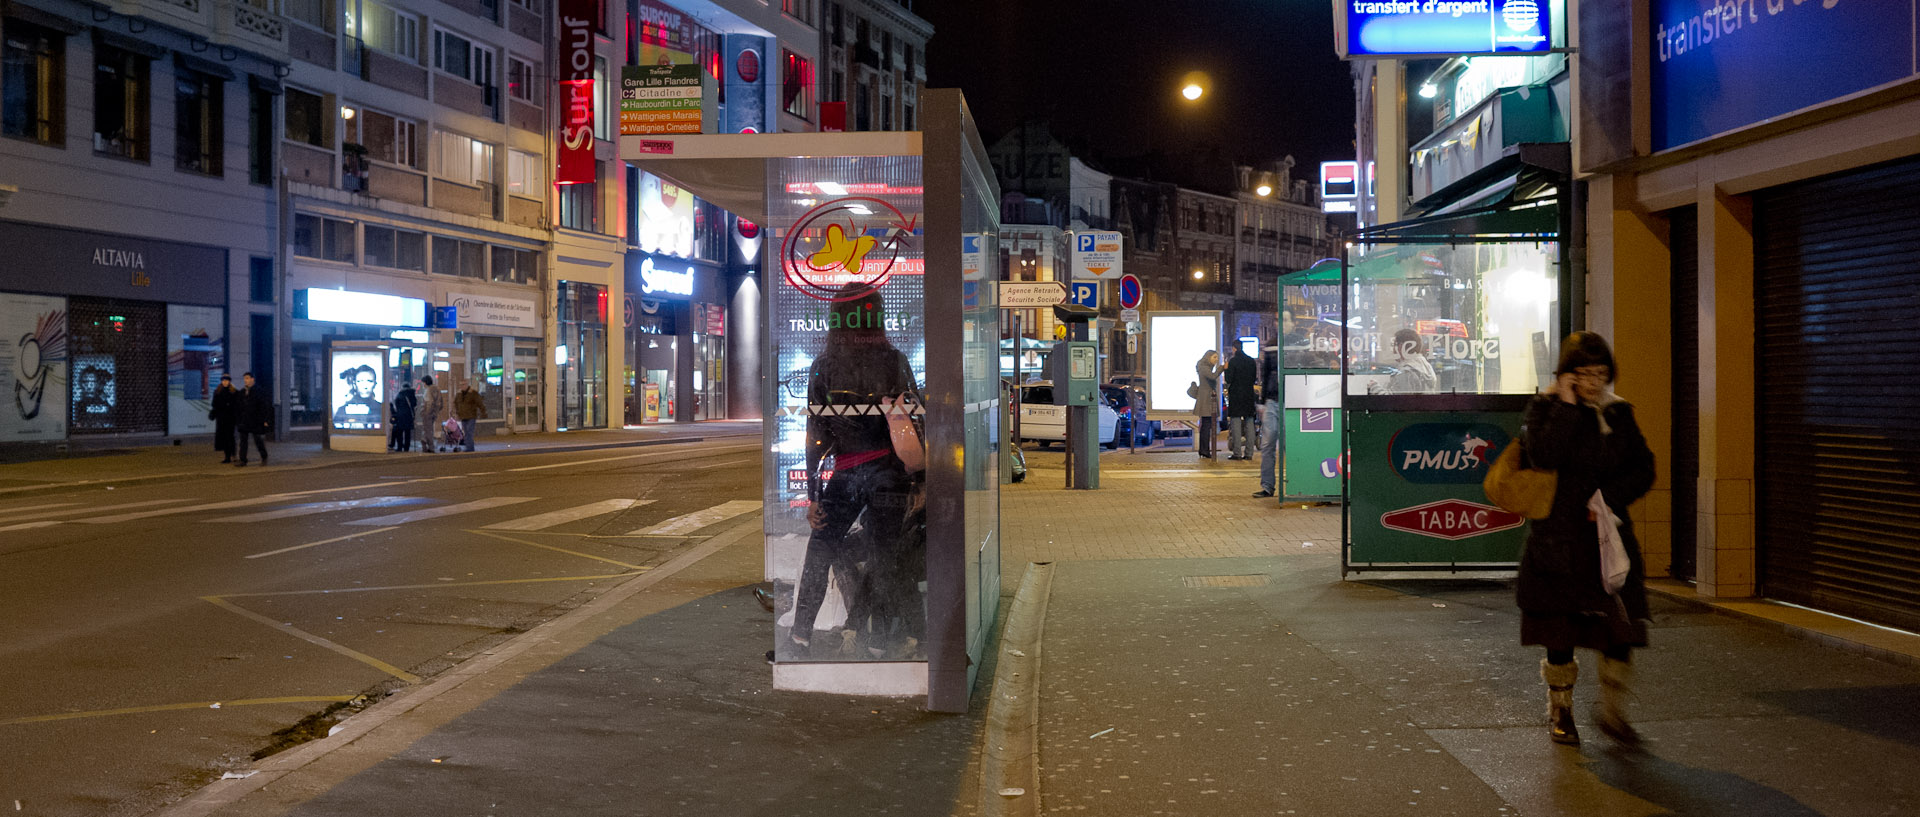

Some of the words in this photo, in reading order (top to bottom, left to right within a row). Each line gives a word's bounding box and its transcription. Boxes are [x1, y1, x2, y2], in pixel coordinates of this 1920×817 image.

[1354, 0, 1420, 14] transfert
[1422, 0, 1488, 18] d'argent
[640, 5, 680, 31] SURCOUF
[1657, 0, 1759, 63] transfert
[562, 15, 594, 151] Surcouf
[624, 78, 645, 87] Gare
[646, 78, 662, 86] Lille
[664, 77, 699, 85] Flandres
[622, 89, 636, 99] C2
[629, 100, 671, 109] Haubourdin
[683, 99, 701, 107] Parc
[629, 112, 671, 122] Wattignies
[628, 124, 665, 133] Wattignies
[666, 123, 700, 131] Cimetière
[1081, 236, 1092, 251] P
[92, 247, 145, 270] ALTAVIA
[901, 262, 914, 272] DU
[131, 271, 151, 287] Lille
[834, 275, 865, 283] JANVIER
[1007, 287, 1032, 296] Agence
[1034, 286, 1060, 294] Retraite
[1077, 286, 1091, 304] P
[1402, 450, 1462, 470] PMU
[1418, 510, 1488, 529] TABAC
